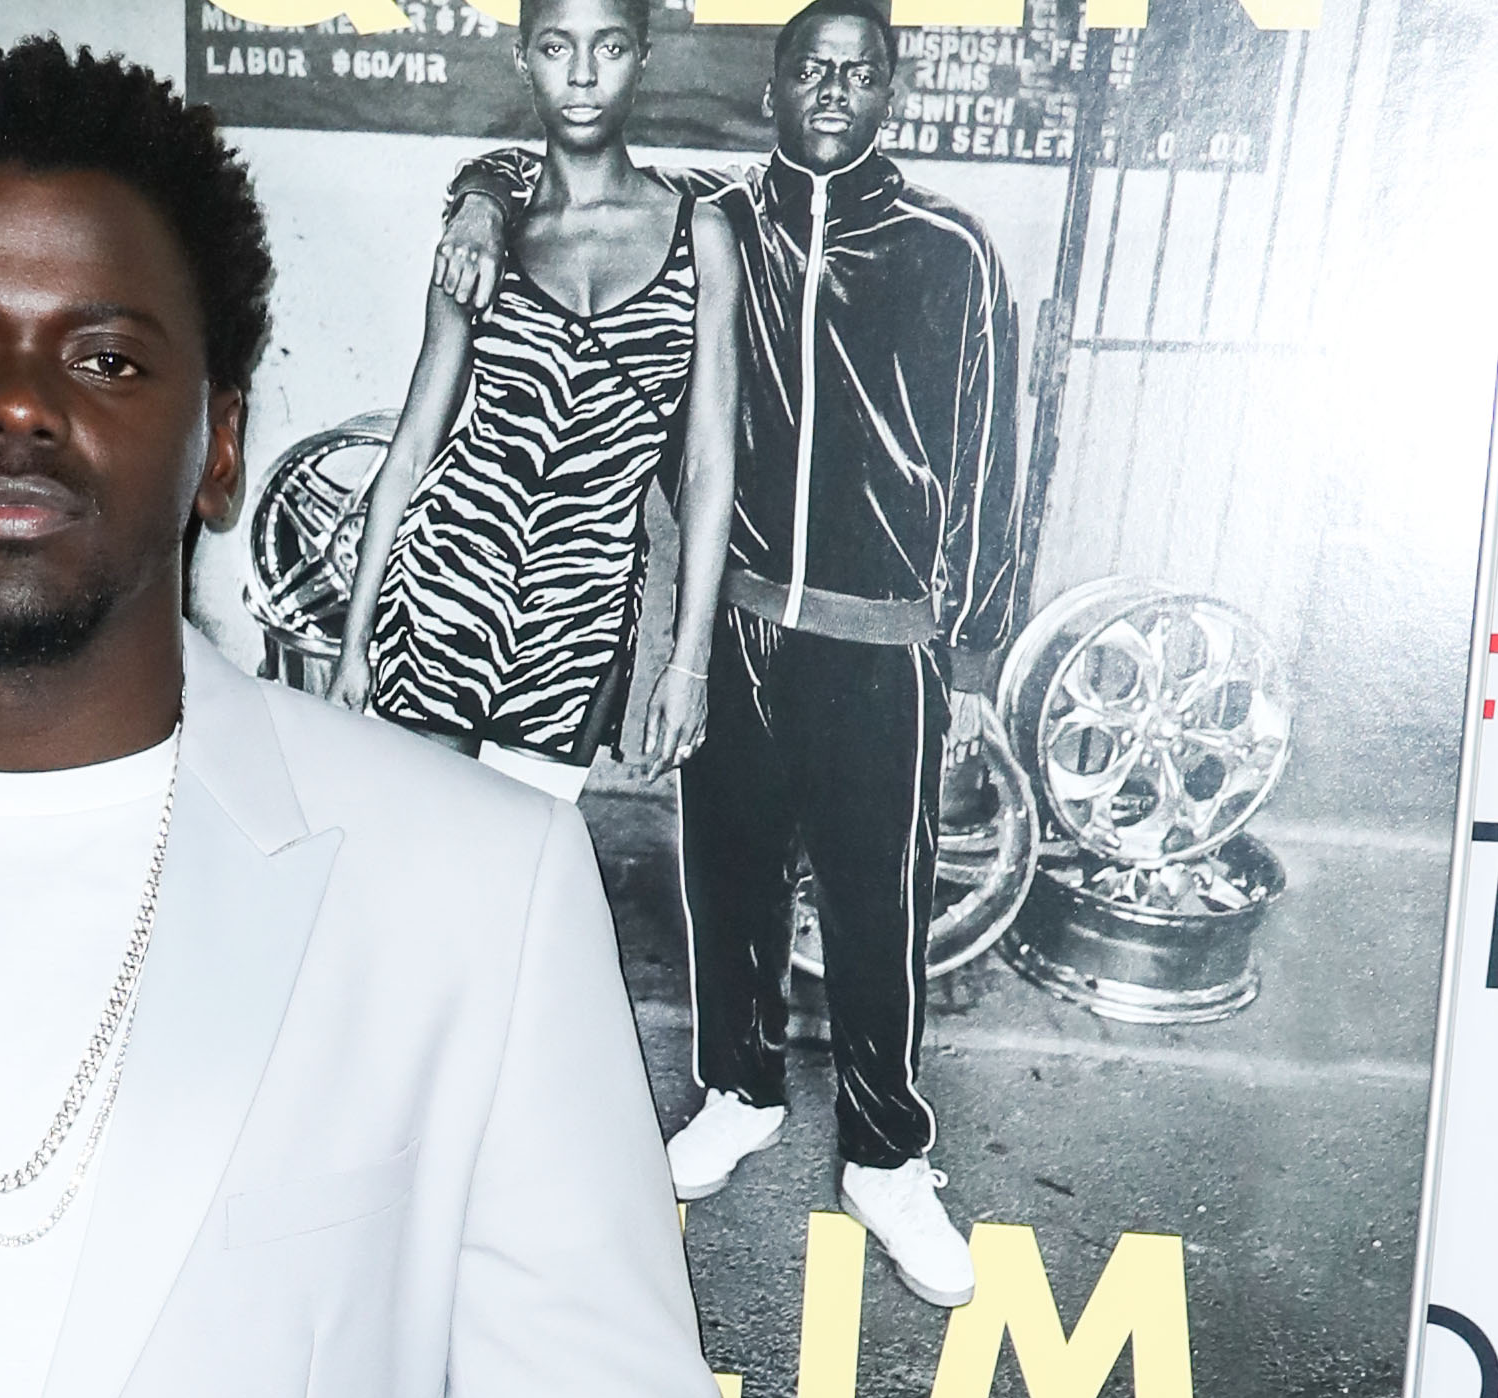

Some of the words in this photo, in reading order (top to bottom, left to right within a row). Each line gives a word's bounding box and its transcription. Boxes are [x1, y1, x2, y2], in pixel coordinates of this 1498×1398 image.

[206, 45, 308, 79] LABOR
[331, 47, 449, 84] $60/HR
[898, 31, 1026, 67] DISPOSAL
[915, 60, 992, 92] RIMS
[904, 93, 1016, 127] SWITCH
[951, 125, 1076, 159] SEALER
